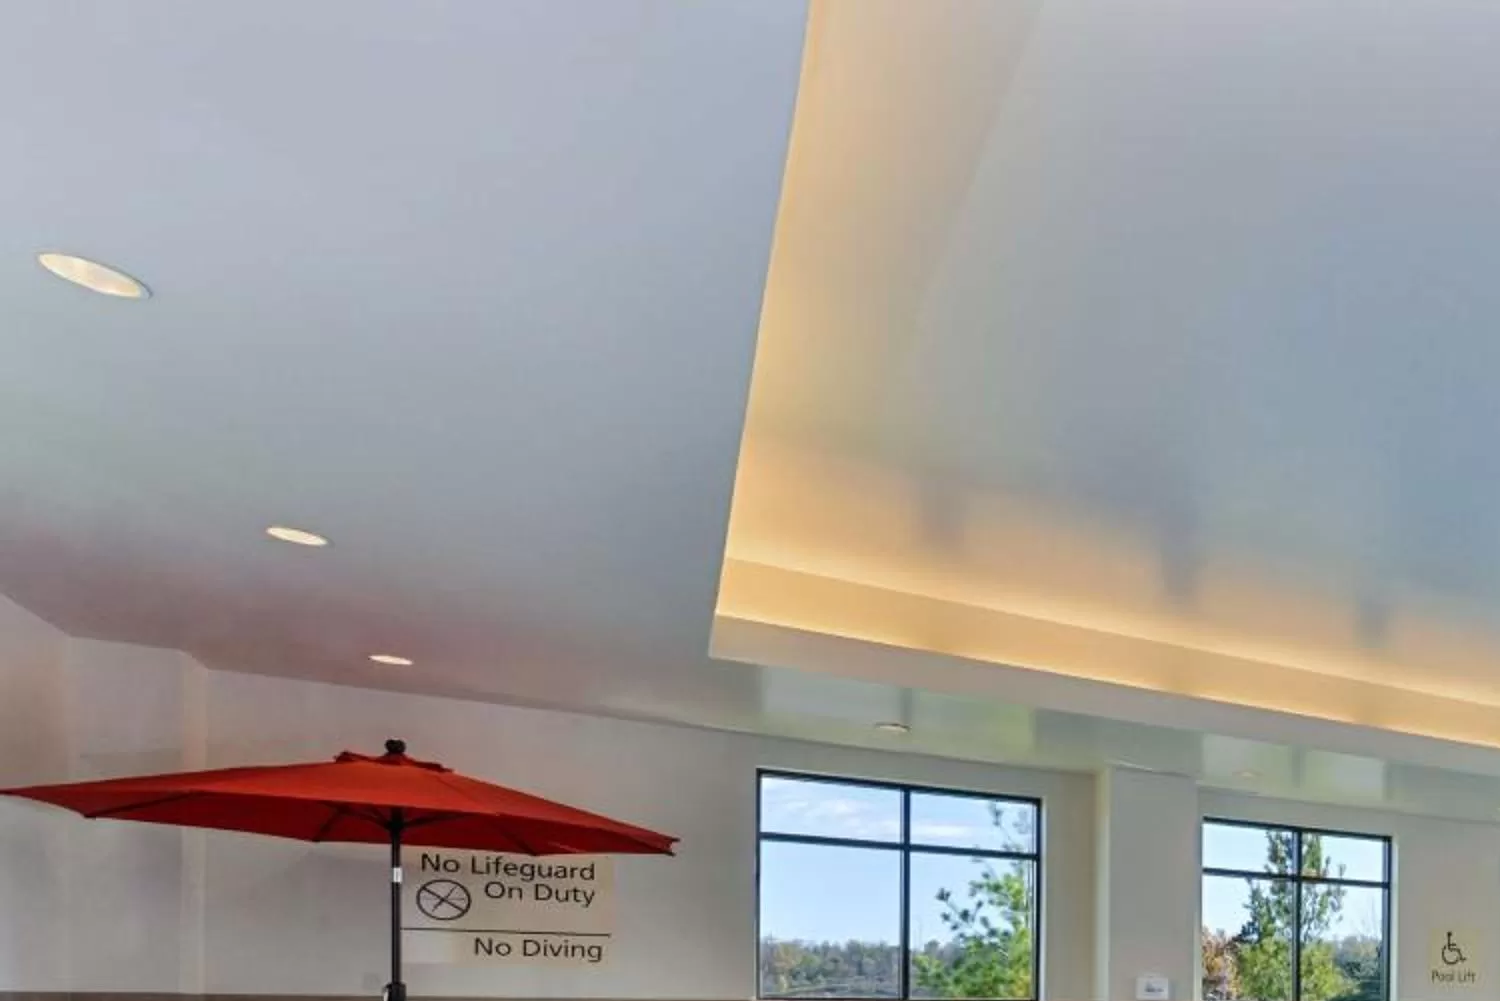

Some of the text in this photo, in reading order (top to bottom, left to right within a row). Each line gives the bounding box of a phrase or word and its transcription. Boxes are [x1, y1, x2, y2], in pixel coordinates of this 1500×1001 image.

[421, 853, 595, 881] No Lifeguard
[484, 881, 595, 908] On Duty
[474, 937, 603, 962] No Diving
[1431, 968, 1476, 984] Pool Lift
